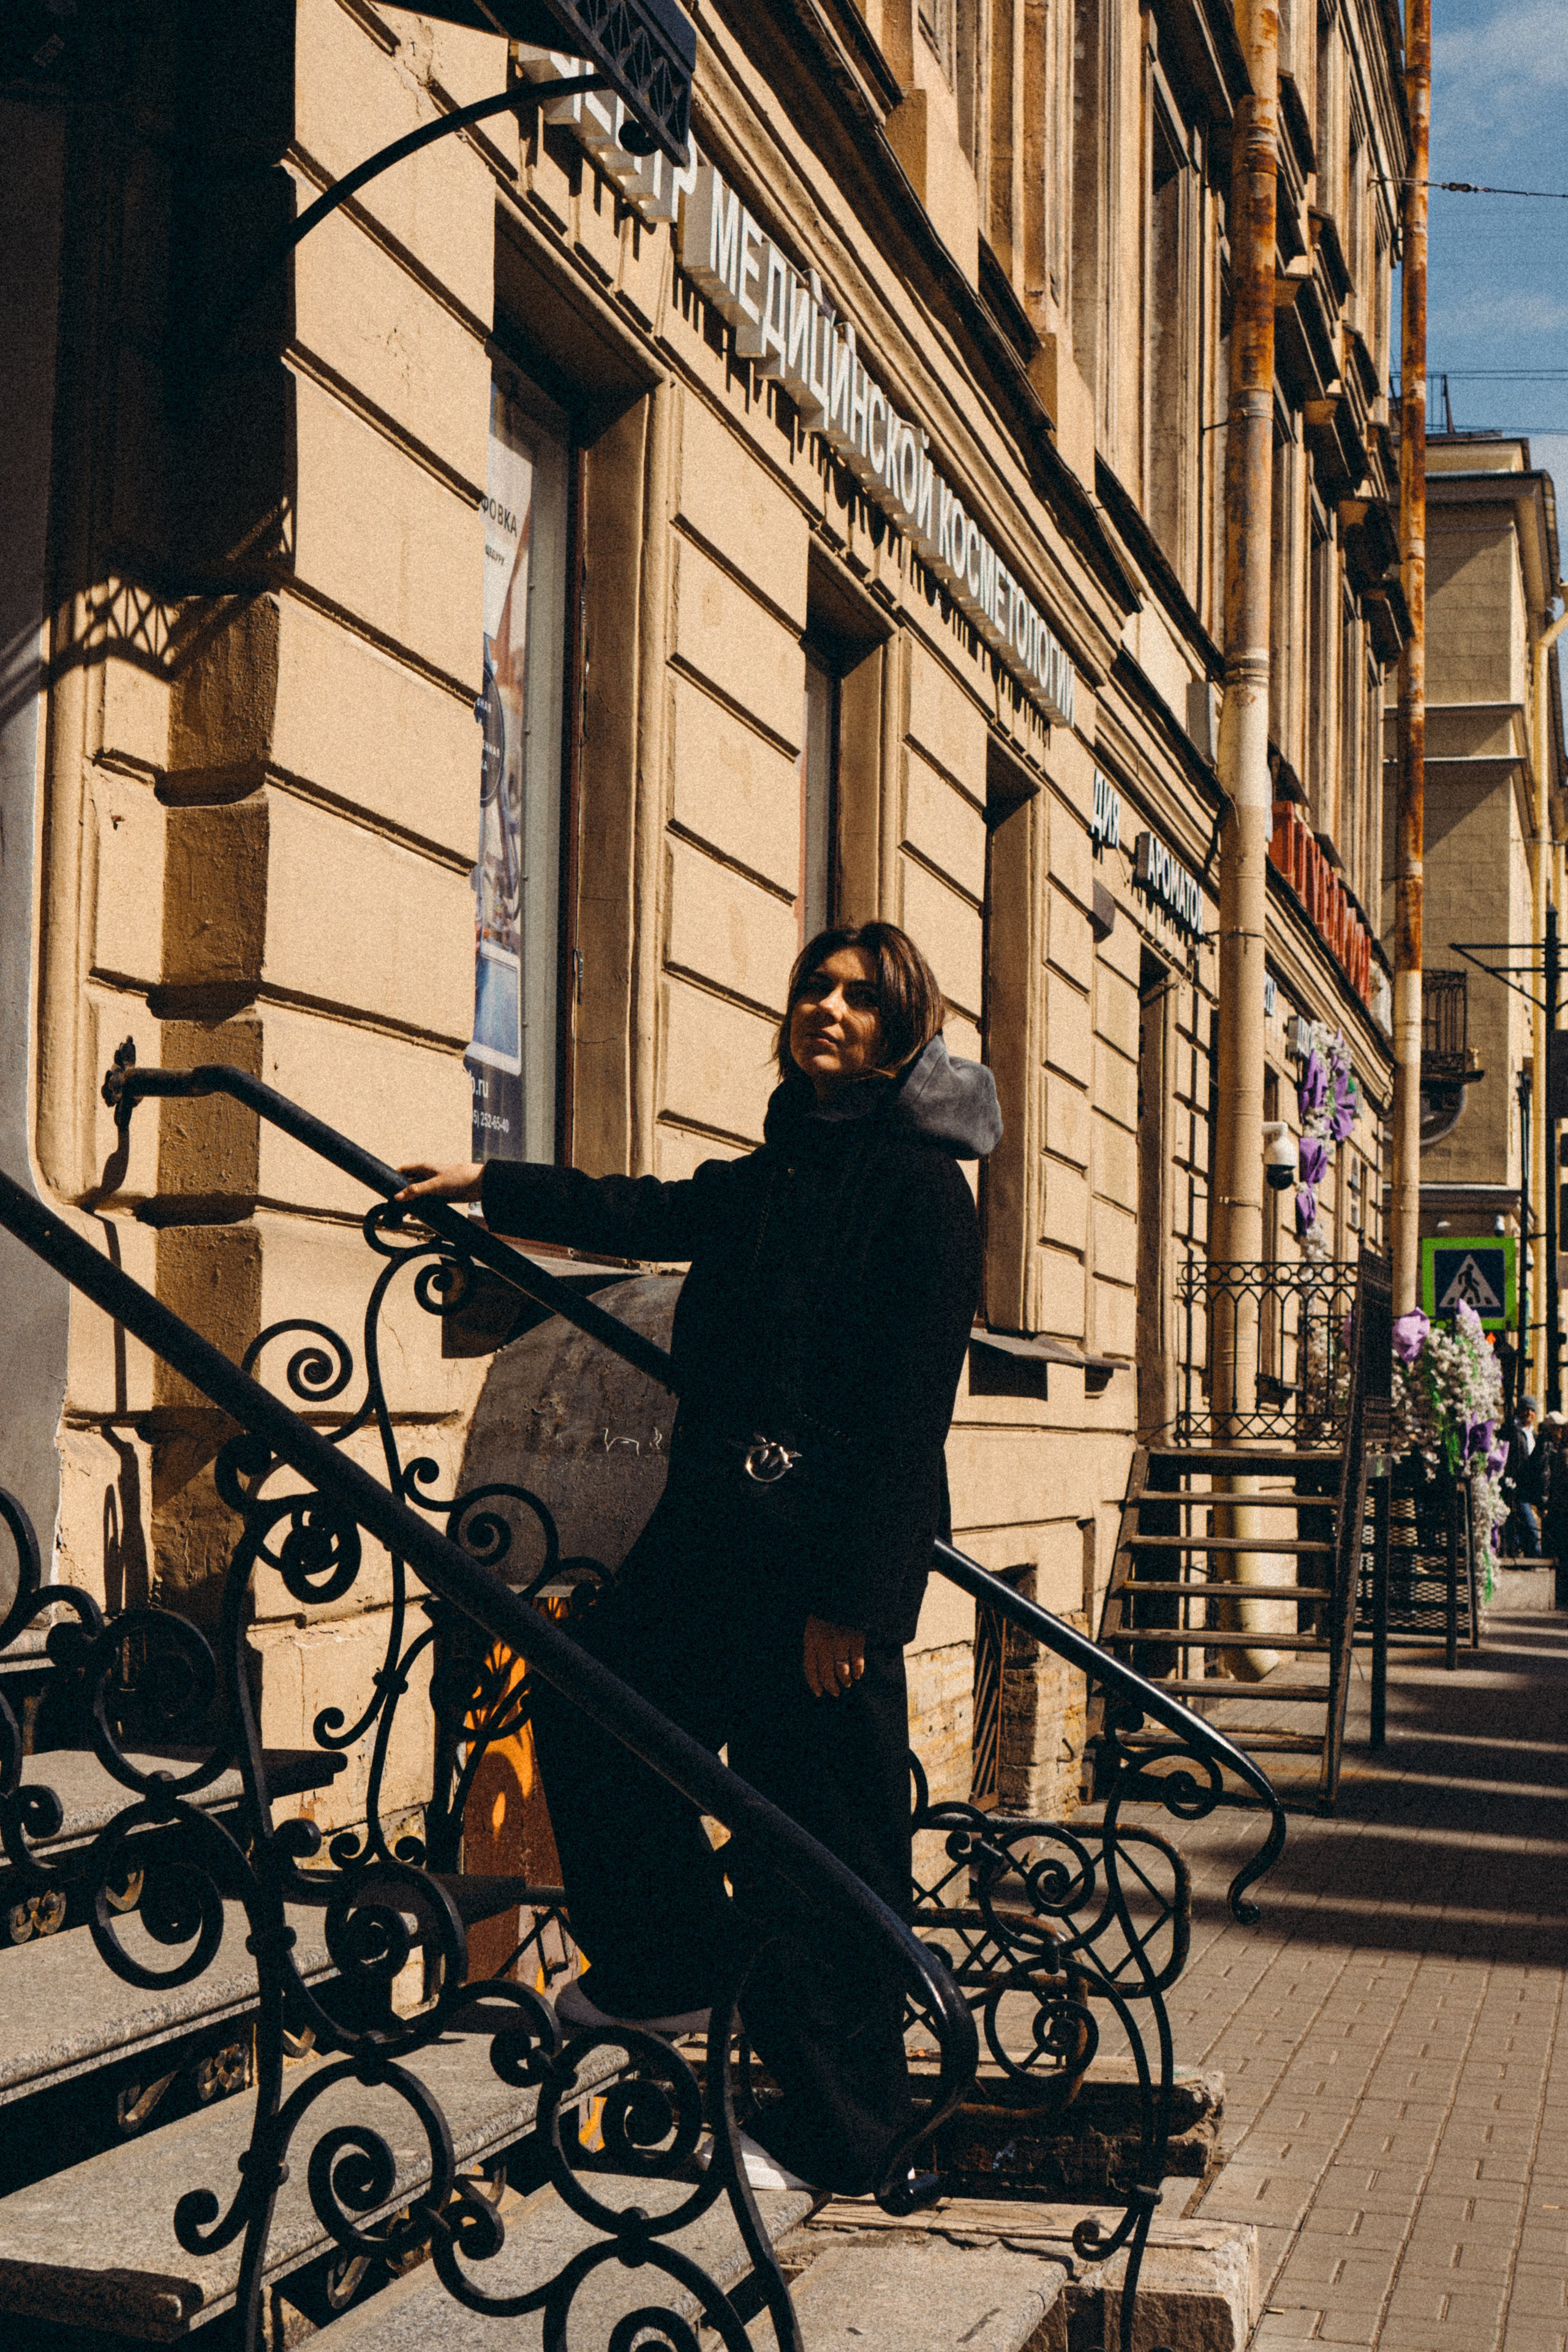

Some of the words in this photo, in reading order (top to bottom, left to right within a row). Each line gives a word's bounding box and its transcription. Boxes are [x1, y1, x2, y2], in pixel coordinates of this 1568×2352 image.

[709, 166, 934, 540] МЕДИЦИНСКОЙ
[939, 477, 1075, 728] КОСМЕТОЛОГИИ
[1147, 832, 1204, 935] АРОМАТОВ
[480, 1112, 509, 1133] 252-65-40
